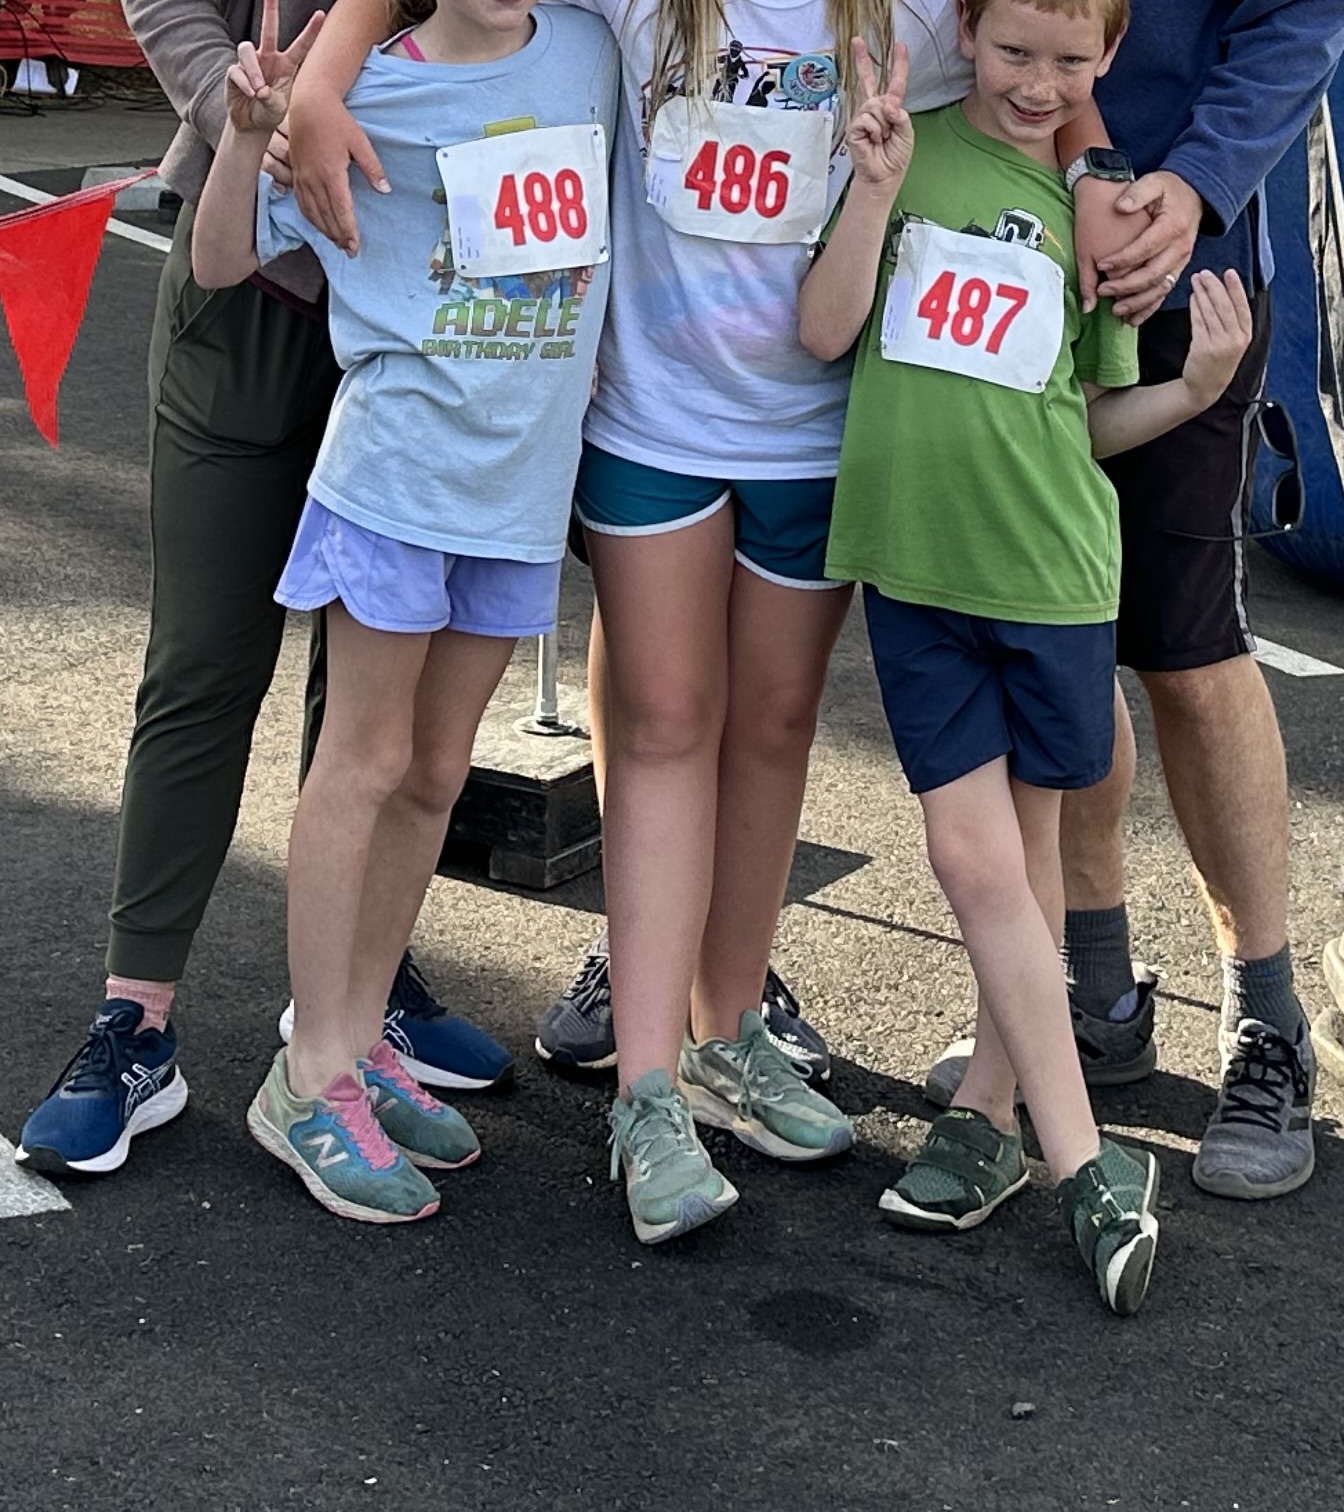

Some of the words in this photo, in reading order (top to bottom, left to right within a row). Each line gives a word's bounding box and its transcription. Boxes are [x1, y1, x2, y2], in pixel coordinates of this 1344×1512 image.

[494, 168, 588, 247] 488
[684, 140, 792, 219] 486
[421, 339, 536, 361] BIRTHDAY
[432, 297, 583, 339] ADELE
[917, 270, 1030, 355] 487
